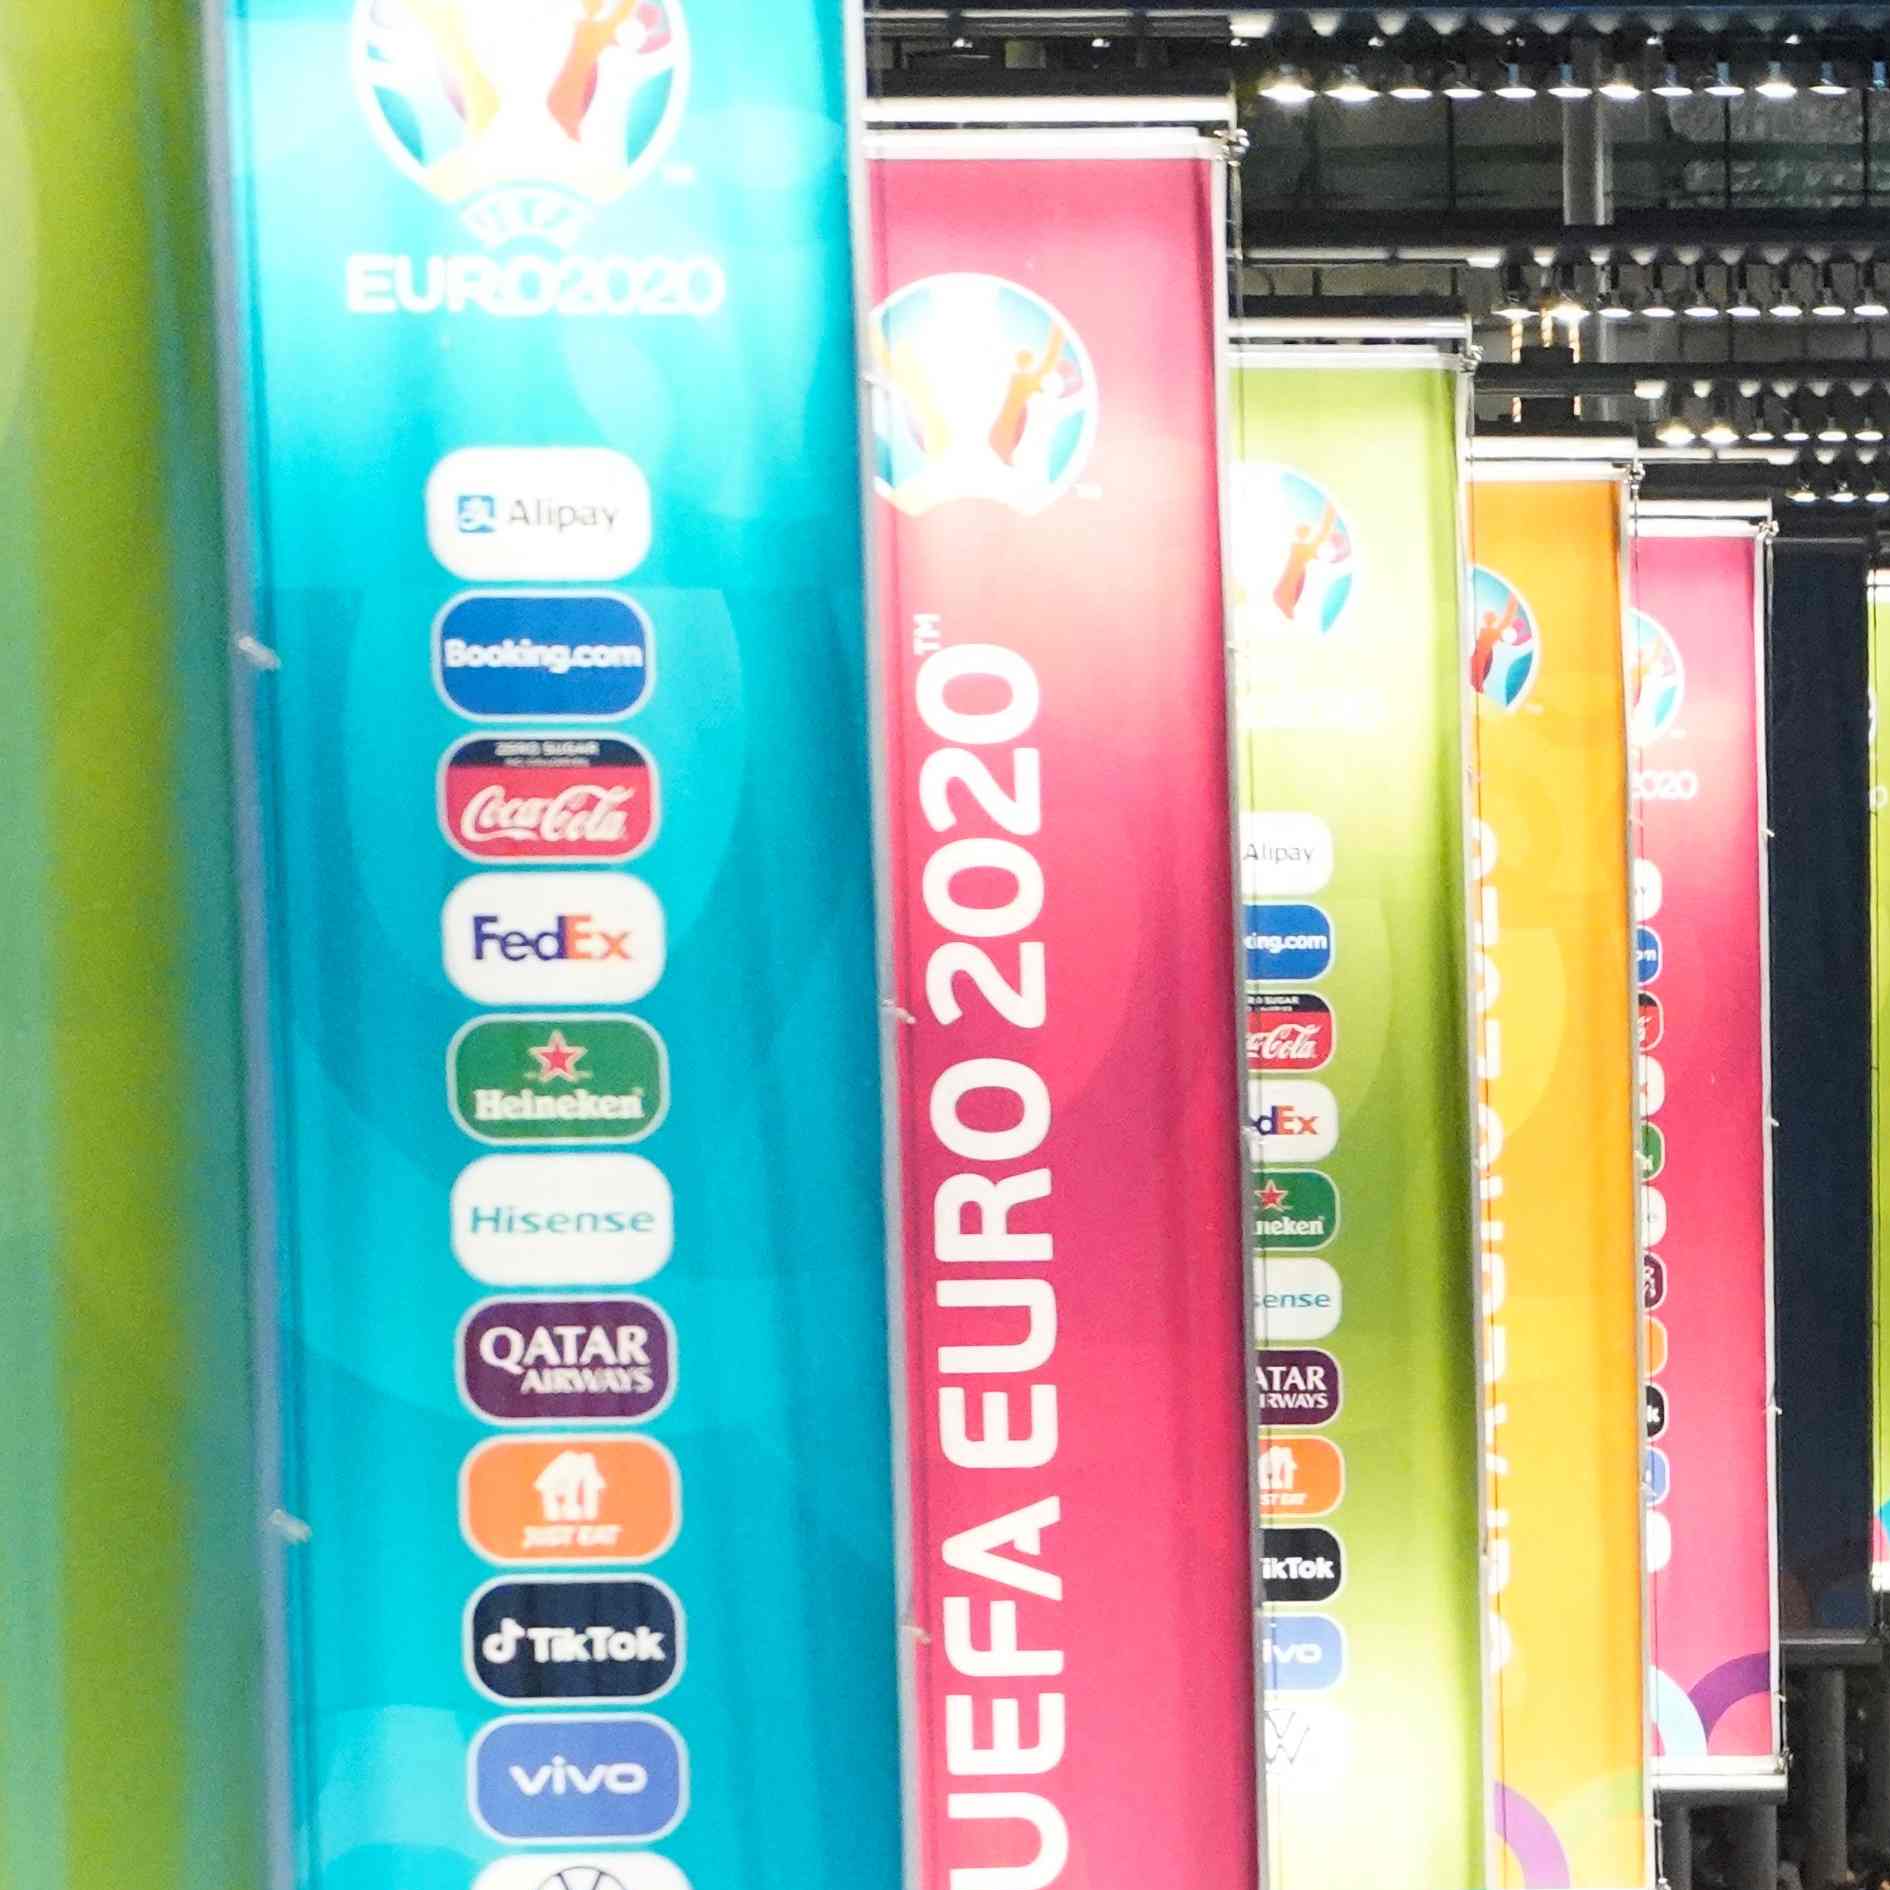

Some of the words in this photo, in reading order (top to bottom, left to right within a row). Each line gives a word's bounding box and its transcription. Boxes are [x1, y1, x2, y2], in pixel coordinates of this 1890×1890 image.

[345, 252, 726, 316] EURO2020
[507, 496, 620, 531] Alipay
[444, 639, 643, 672] Booking.com
[914, 644, 1047, 1029] 2020
[1243, 844, 1315, 863] Alipay
[473, 916, 632, 960] FedEx
[474, 1088, 643, 1120] Heineken
[1250, 1104, 1318, 1136] dEx
[470, 1206, 655, 1234] Hisense
[929, 1057, 1059, 1469] EURO
[480, 1326, 650, 1371] QATAR
[521, 1368, 654, 1394] AIRWAYS
[1256, 1365, 1325, 1391] ATAR
[1259, 1392, 1328, 1409] IRWAYS
[527, 1627, 665, 1663] TikTok
[510, 1756, 648, 1795] vivo
